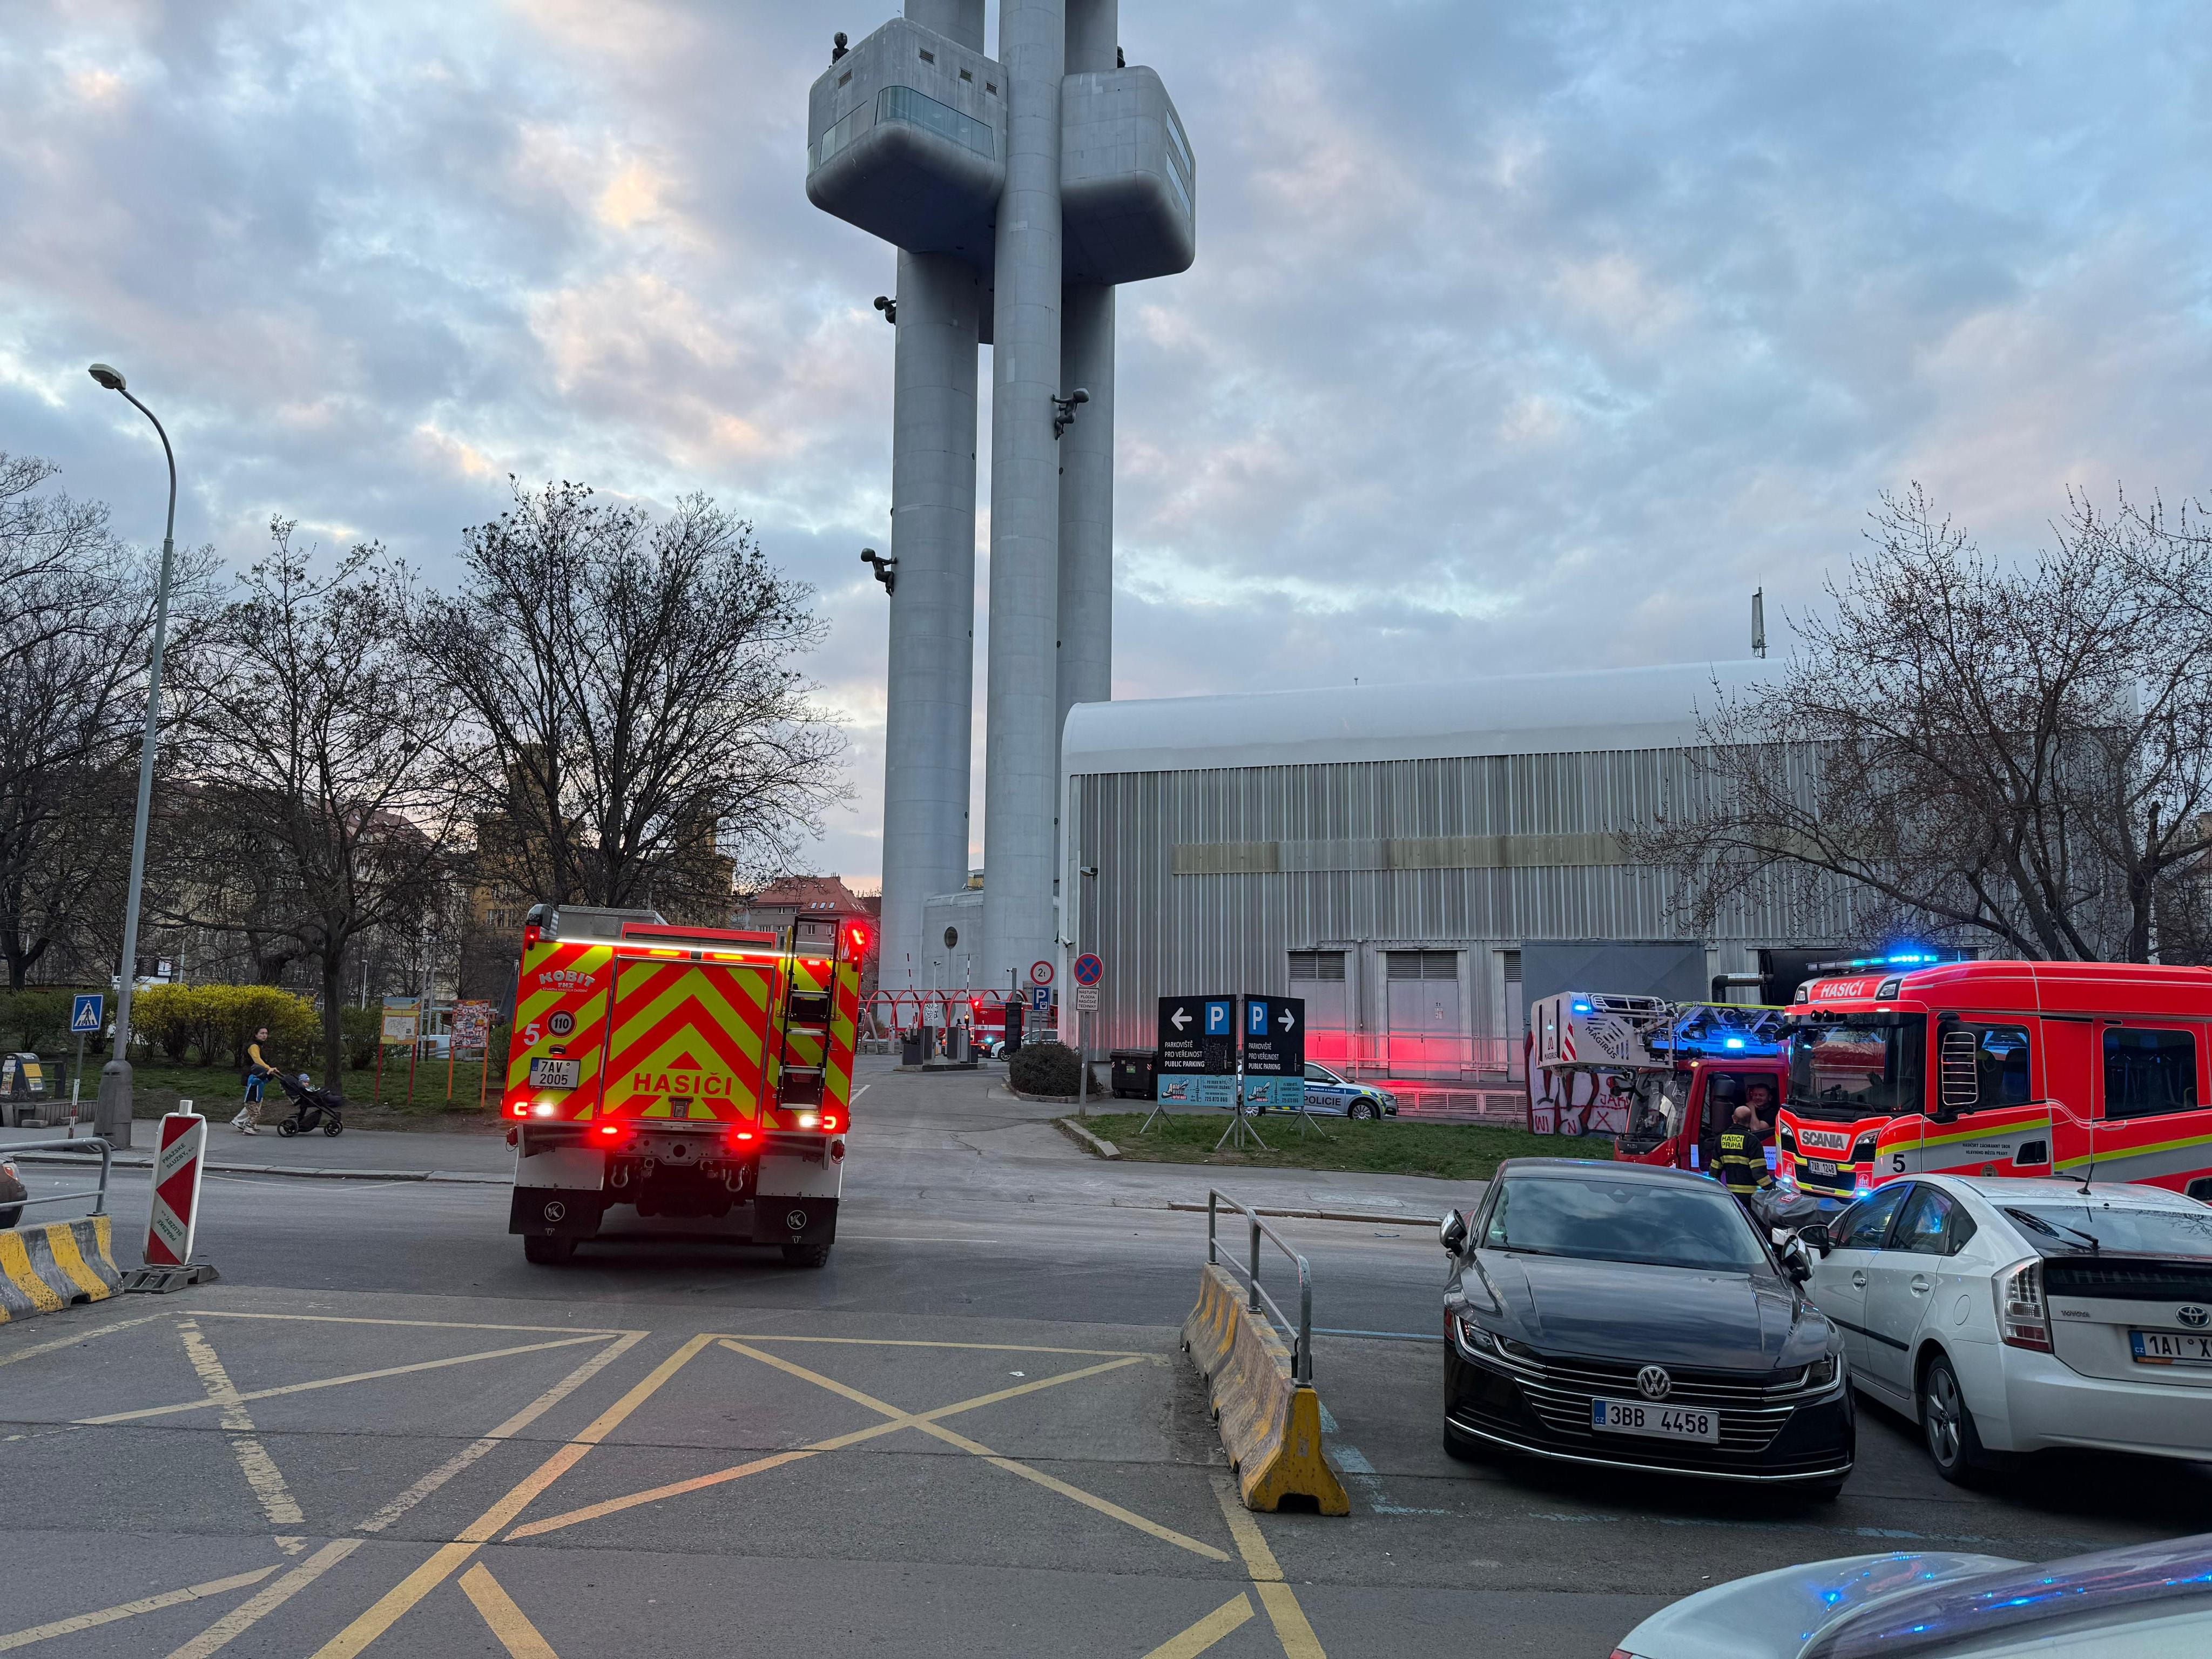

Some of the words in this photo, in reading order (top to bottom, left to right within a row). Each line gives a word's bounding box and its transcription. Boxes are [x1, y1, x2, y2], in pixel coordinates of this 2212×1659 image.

[539, 970, 595, 987] KOBIT
[1036, 989, 1047, 1004] P
[554, 1018, 569, 1029] 110
[1211, 1006, 1224, 1030] P
[1253, 1006, 1263, 1030] P
[523, 1023, 540, 1046] 5
[1585, 1026, 1618, 1059] MAGIRUS
[1175, 1049, 1203, 1058] VEŘEJNOST
[1249, 1042, 1271, 1050] PARKOVIŠTĚ
[1257, 1052, 1279, 1060] VEŘEJNOST
[541, 1061, 563, 1073] 7AV
[540, 1074, 568, 1085] 2005
[633, 1072, 732, 1096] HASIČI
[1802, 1131, 1844, 1149] SCANIA
[1811, 1161, 1820, 1171] 7AR
[1823, 1163, 1835, 1174] 1248
[1892, 1154, 1906, 1173] 5
[1610, 1406, 1645, 1427] 3BB
[1661, 1411, 1708, 1434] 4458
